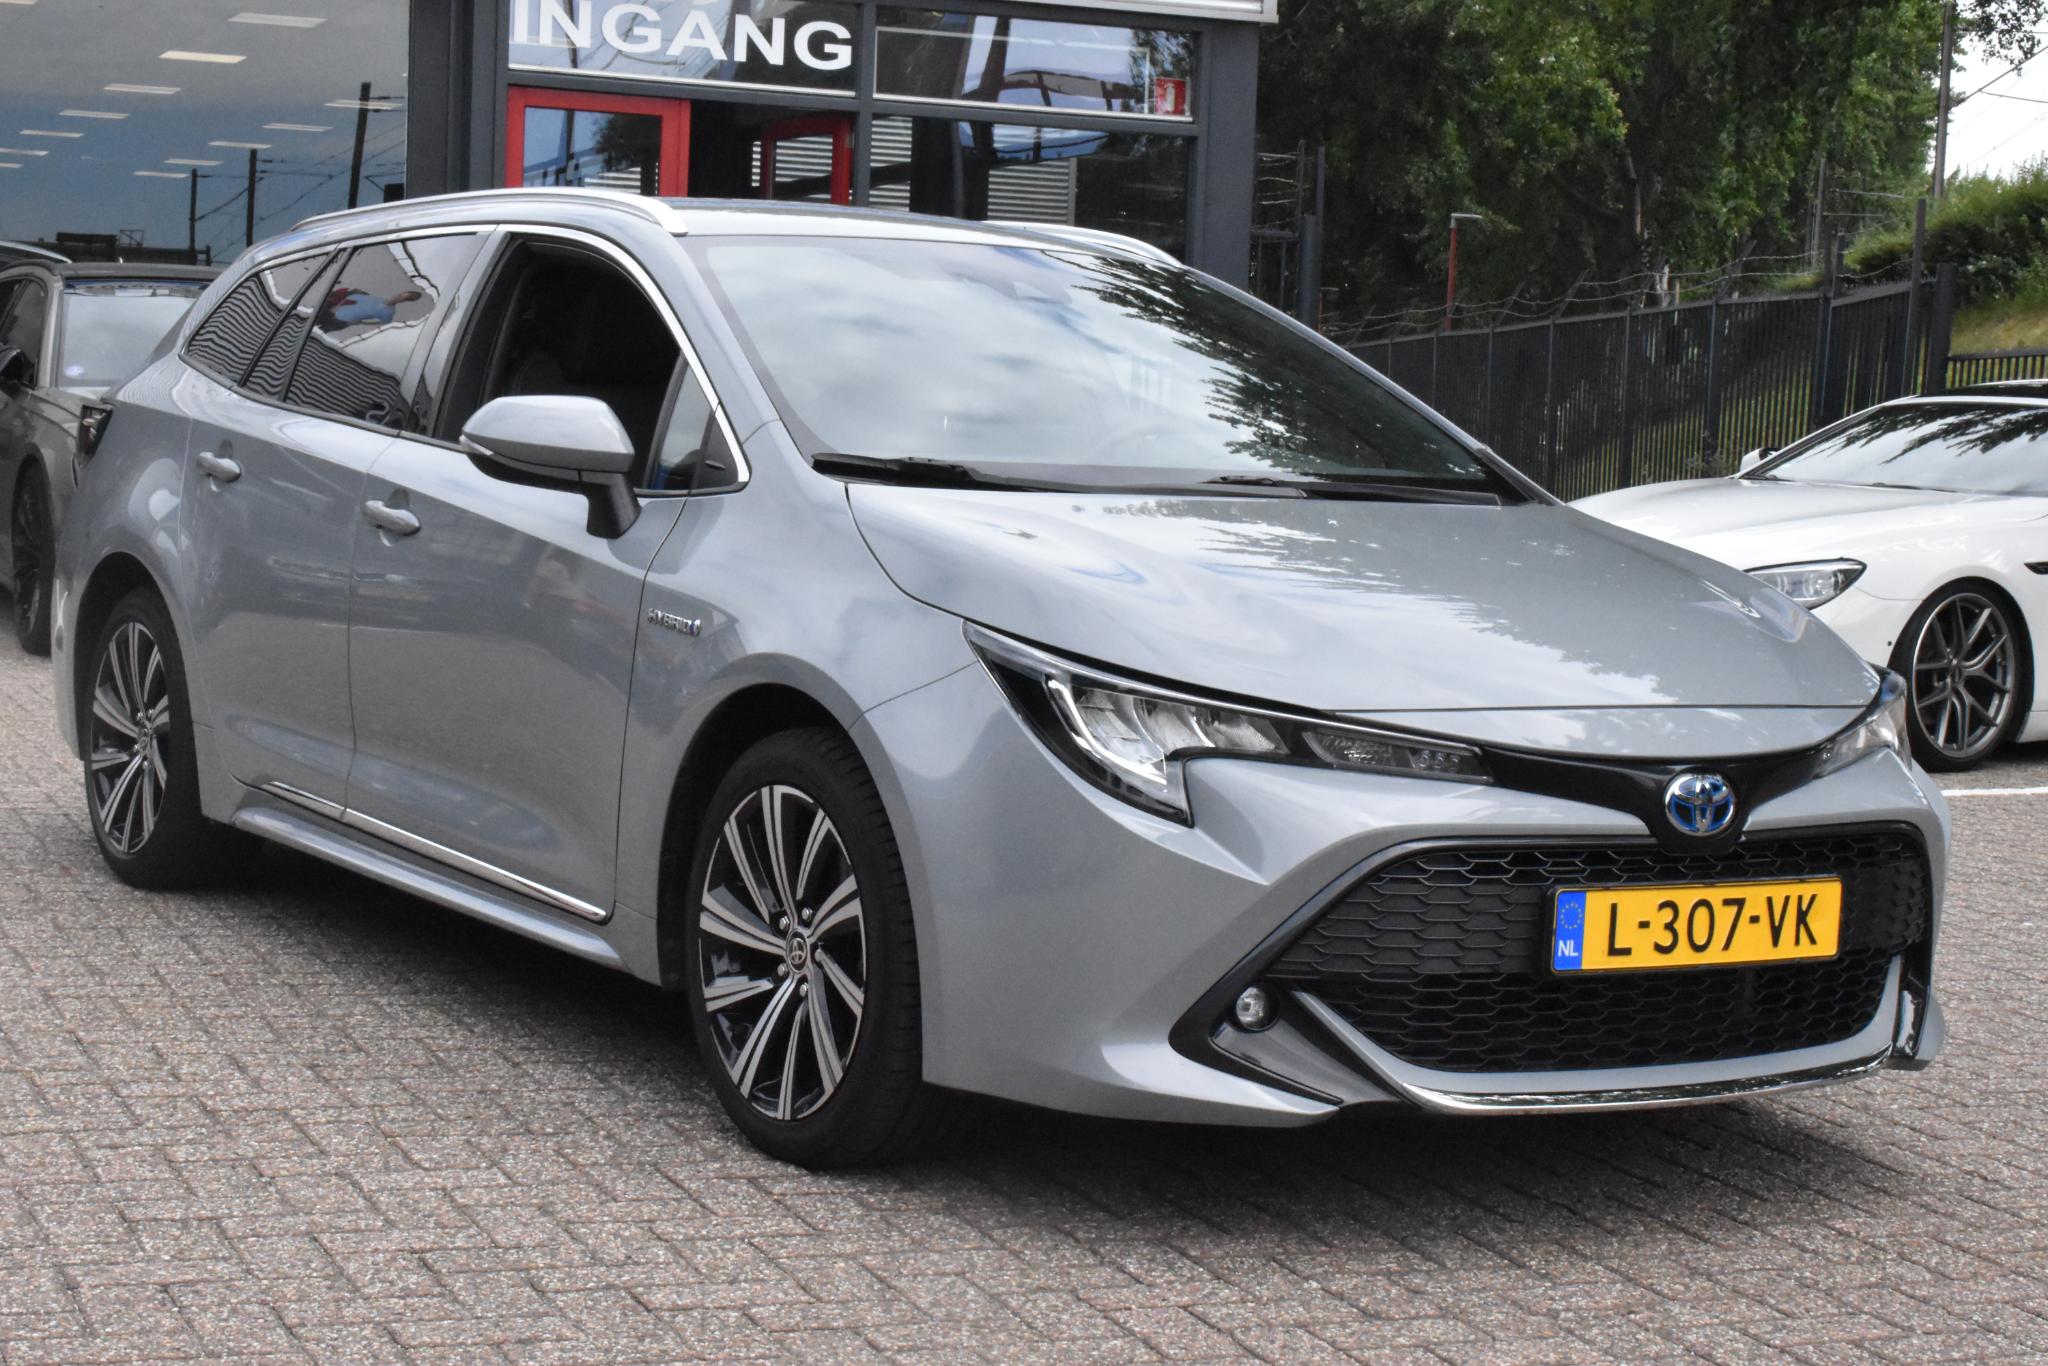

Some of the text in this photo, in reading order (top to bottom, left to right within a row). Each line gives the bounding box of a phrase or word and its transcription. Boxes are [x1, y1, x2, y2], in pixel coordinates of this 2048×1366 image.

[513, 0, 852, 71] INGANG
[1558, 939, 1579, 957] NL
[1607, 893, 1818, 957] L-307-VK
